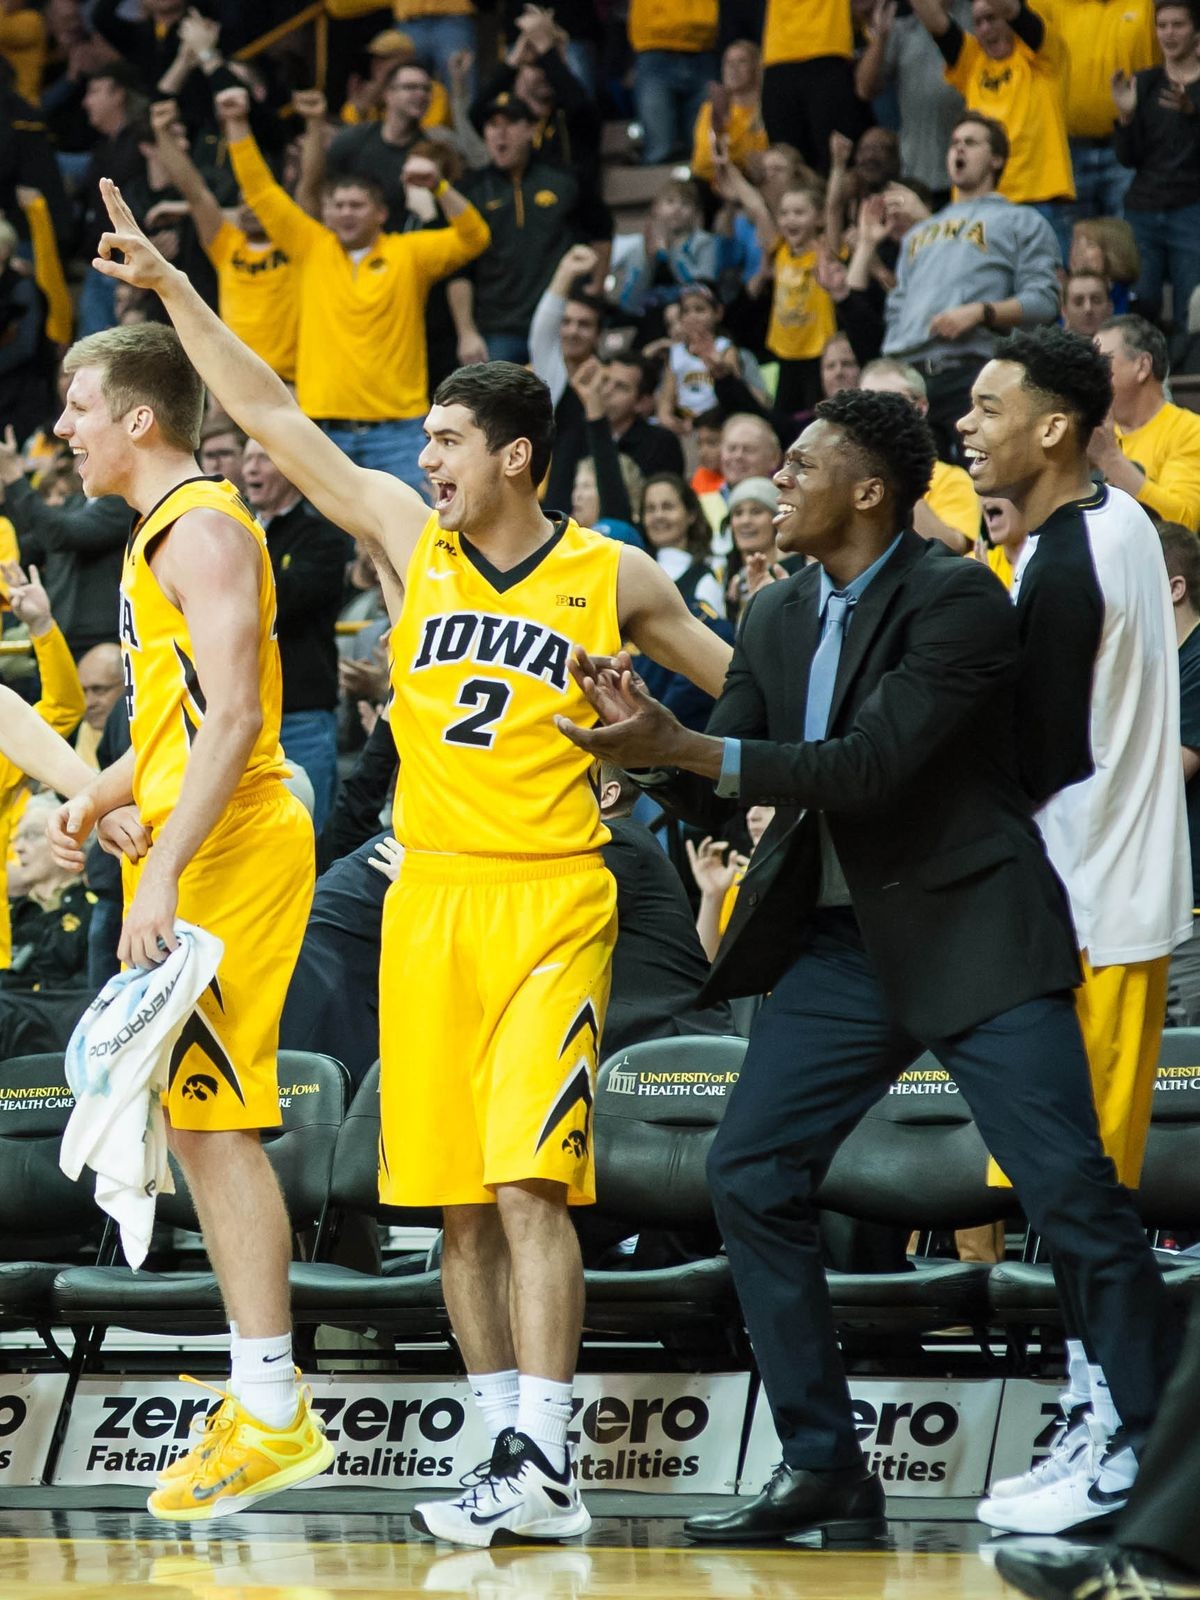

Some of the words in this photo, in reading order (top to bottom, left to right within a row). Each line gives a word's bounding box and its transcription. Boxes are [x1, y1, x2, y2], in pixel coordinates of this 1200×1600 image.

[411, 611, 572, 693] IOWA
[443, 677, 512, 748] 2
[640, 1072, 711, 1084] UNIVERSITY
[725, 1072, 740, 1083] IO
[292, 1083, 320, 1096] IOWA
[638, 1084, 690, 1096] HEALTH
[693, 1083, 726, 1096] CARE
[888, 1083, 942, 1095] HEALTH
[1153, 1079, 1188, 1091] ALTH
[0, 1086, 62, 1099] UNIVERSITY
[45, 1097, 75, 1109] CARE
[278, 1097, 292, 1108] RE
[310, 1396, 465, 1442] zero
[851, 1399, 959, 1447] ero
[319, 1447, 454, 1477] talities
[572, 1448, 700, 1480] talities
[863, 1451, 947, 1482] lities
